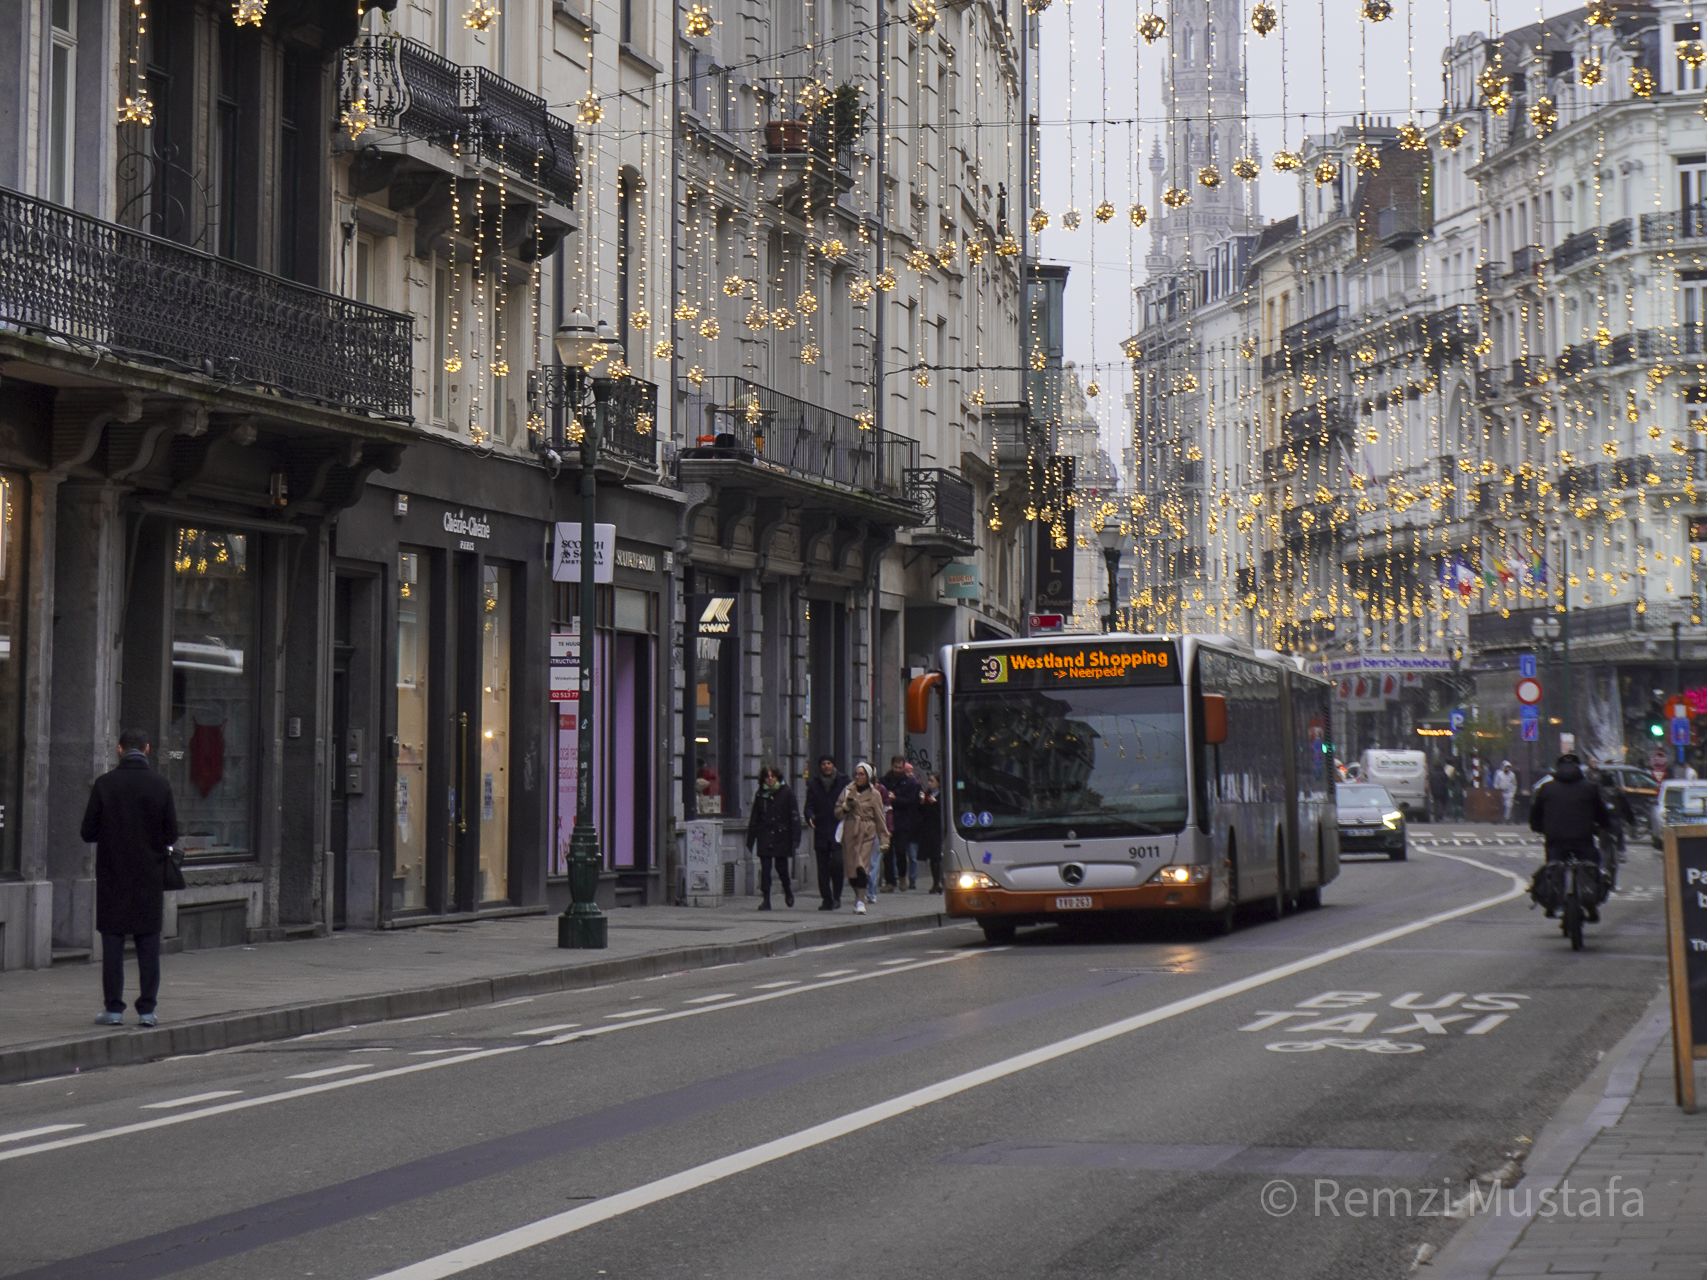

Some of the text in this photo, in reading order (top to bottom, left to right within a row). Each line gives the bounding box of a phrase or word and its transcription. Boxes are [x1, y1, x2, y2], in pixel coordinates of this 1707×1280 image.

[1010, 651, 1085, 670] Westland
[1089, 650, 1168, 668] Shopping
[1069, 666, 1126, 680] Neerpede
[1129, 846, 1160, 859] 9011
[1295, 991, 1531, 1010] BUS
[1238, 1011, 1510, 1034] TAXI
